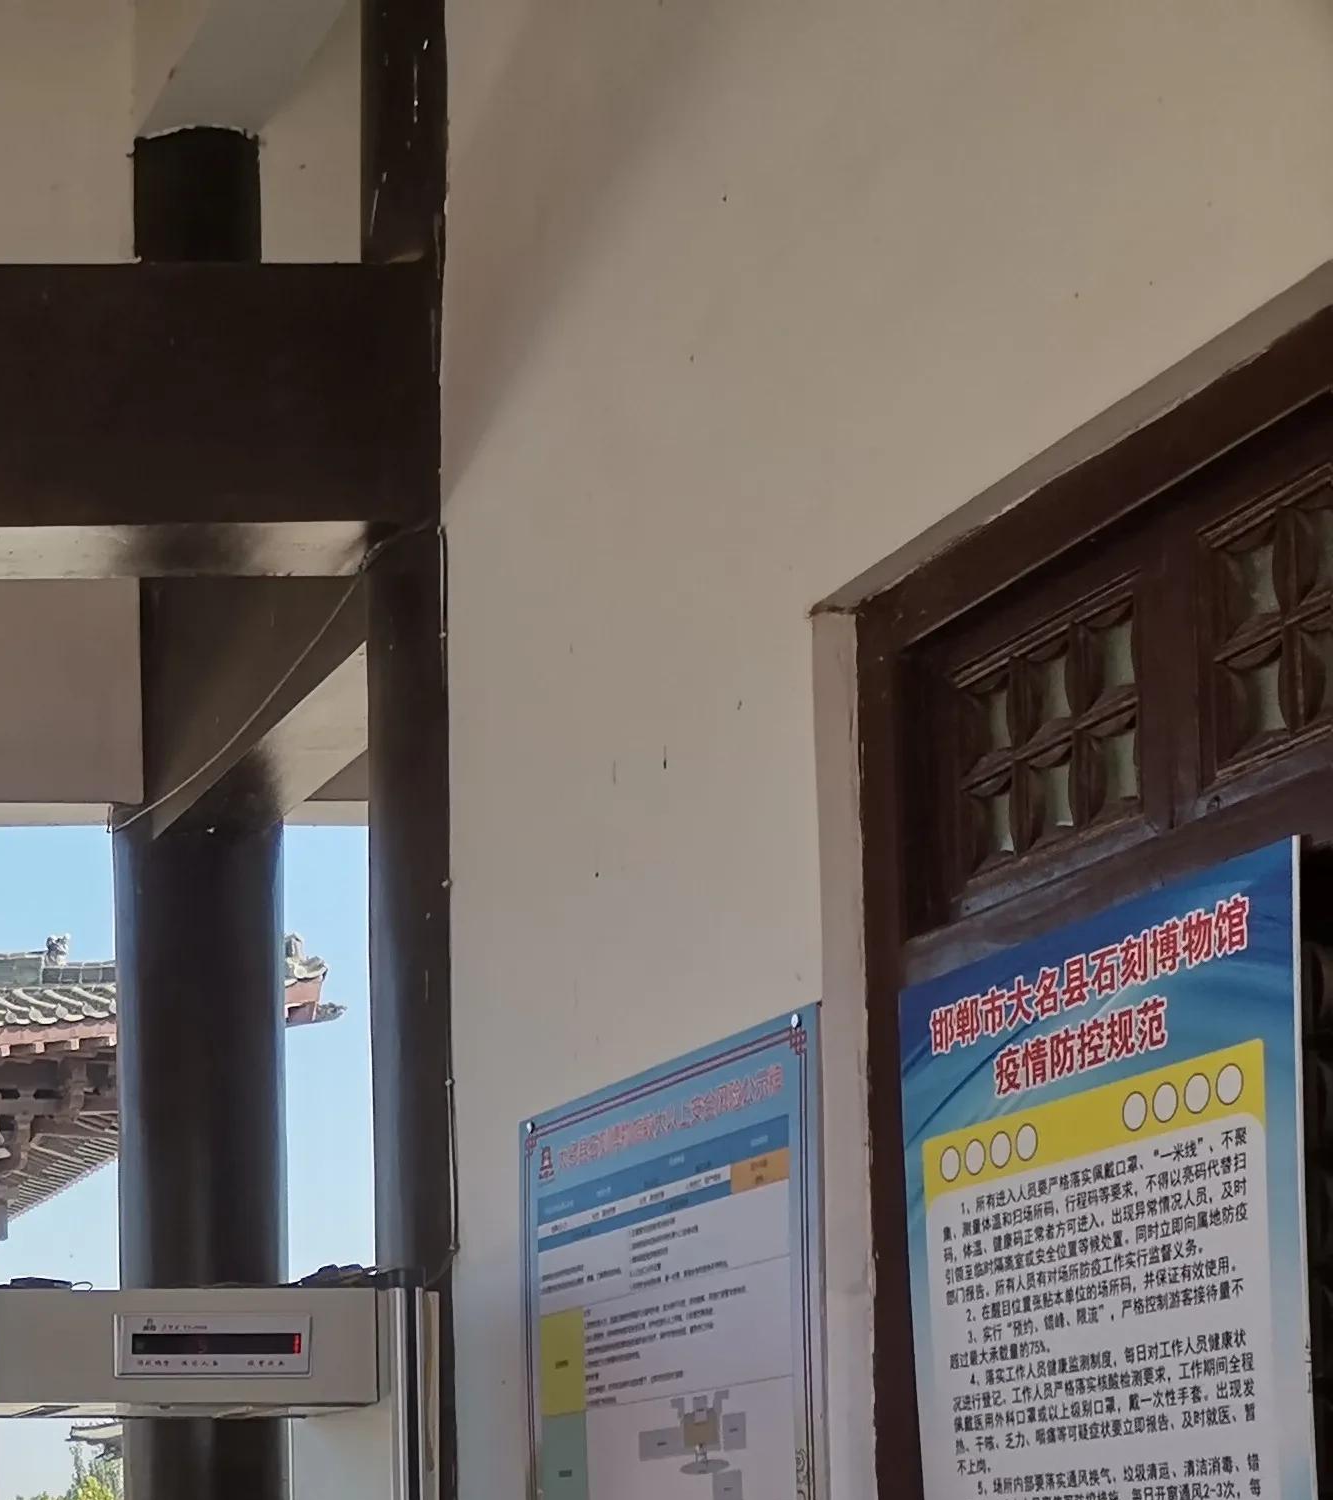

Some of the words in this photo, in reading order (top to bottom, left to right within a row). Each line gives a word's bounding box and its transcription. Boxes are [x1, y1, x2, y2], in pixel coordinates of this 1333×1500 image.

[930, 895, 1249, 1054] 邯郸市大名县石刻博物馆
[994, 997, 1168, 1096] 疫情防控规范
